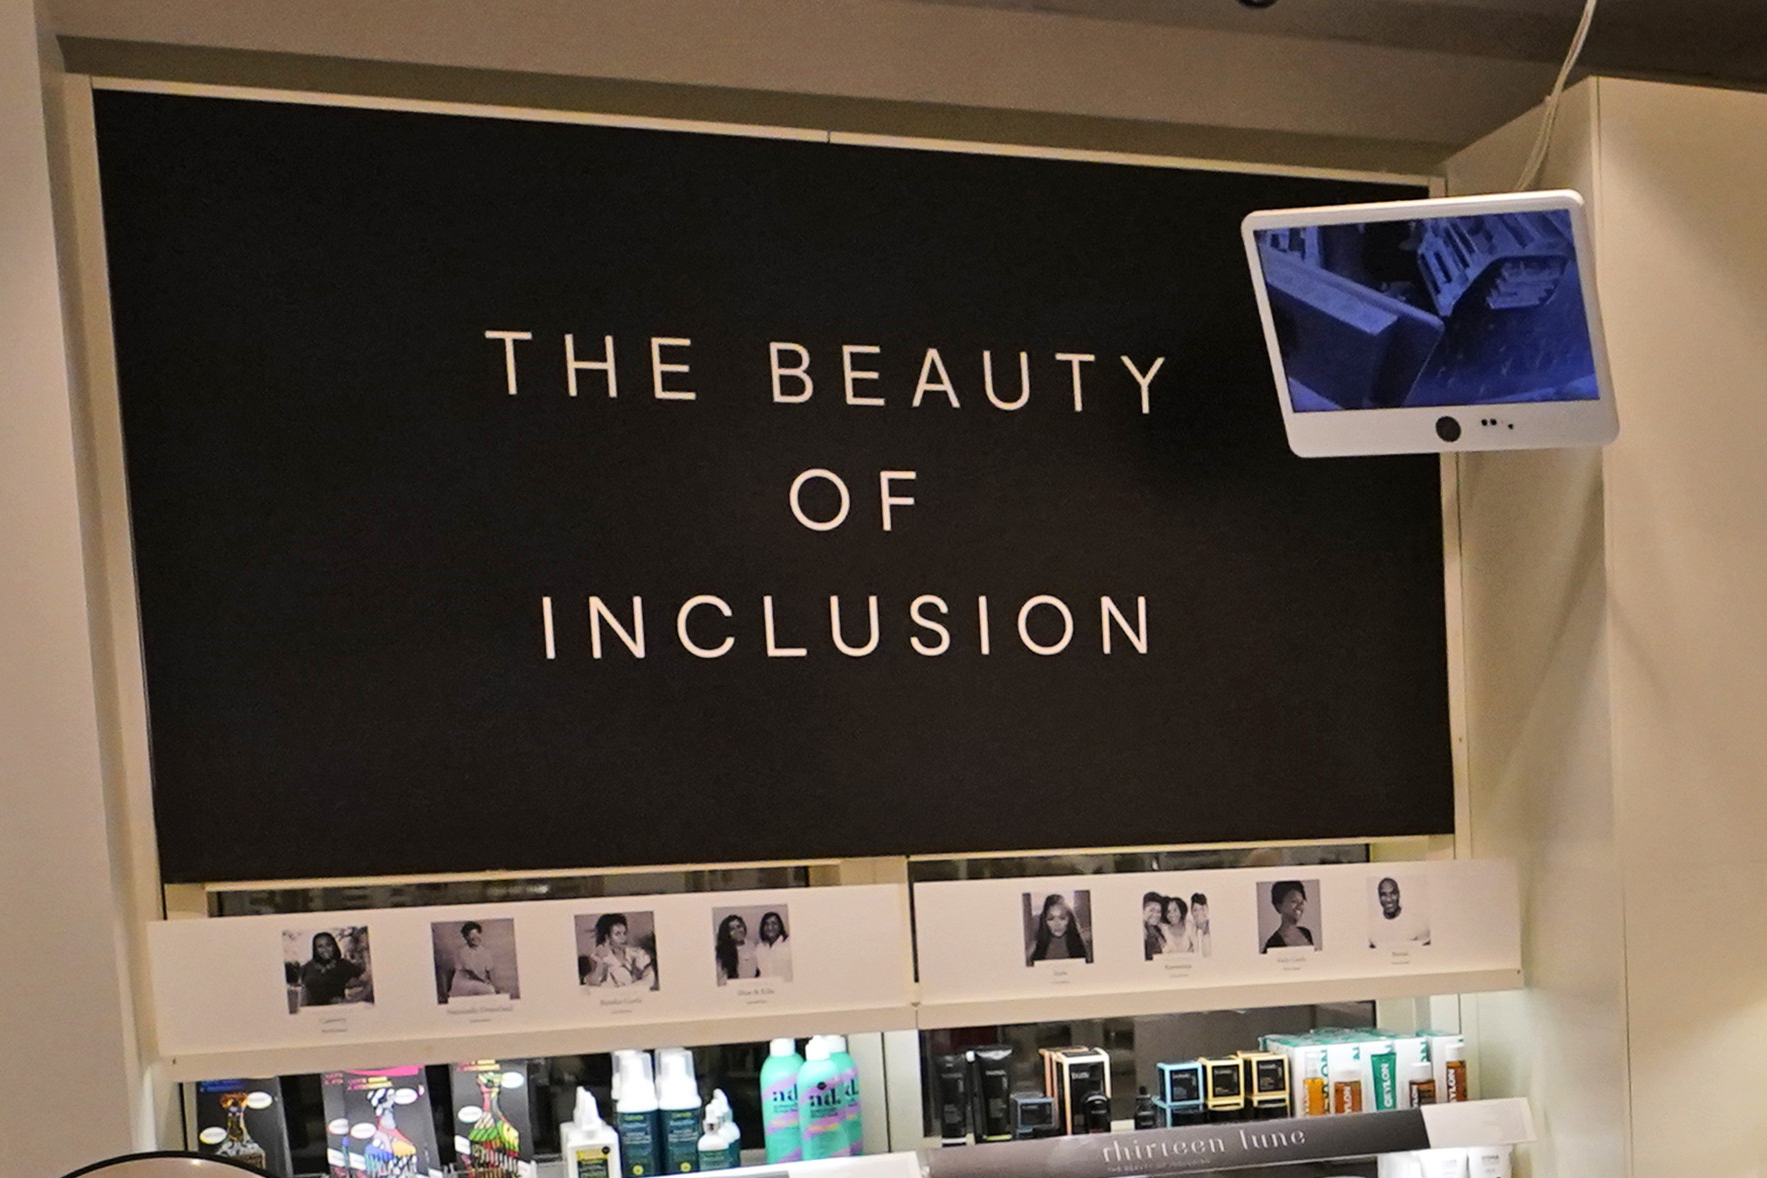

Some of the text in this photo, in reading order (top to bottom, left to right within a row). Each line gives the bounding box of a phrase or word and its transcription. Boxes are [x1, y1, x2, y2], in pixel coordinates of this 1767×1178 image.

[485, 330, 1167, 414] THE BEAUTY
[789, 468, 917, 532] OF
[543, 594, 1148, 660] INCLUSION
[1383, 1063, 1393, 1107] CEYLON
[1103, 1129, 1306, 1163] thirteen lune
